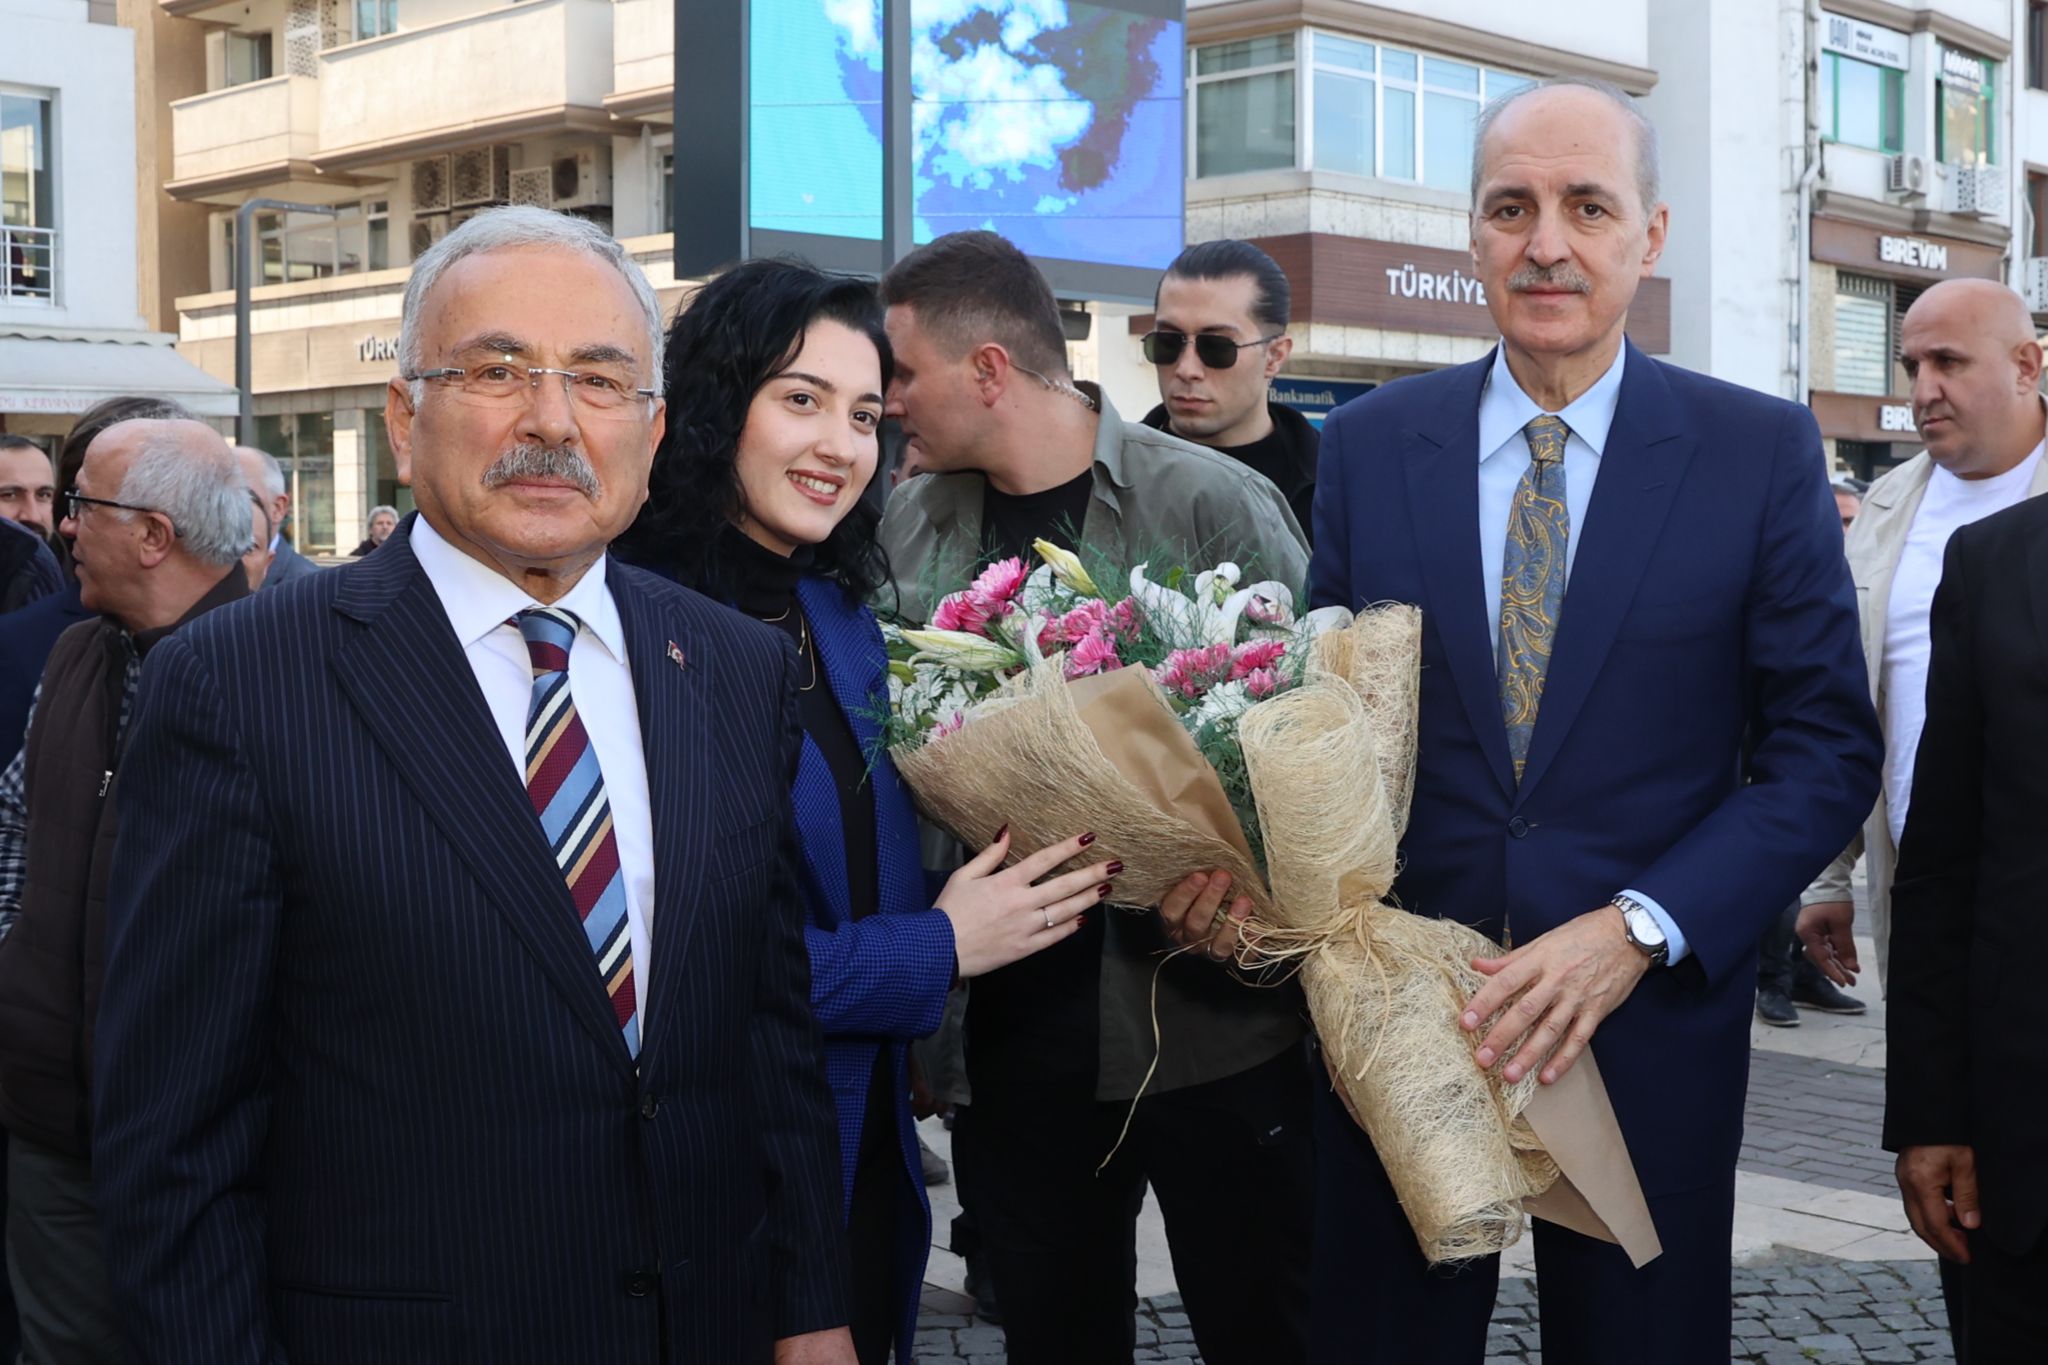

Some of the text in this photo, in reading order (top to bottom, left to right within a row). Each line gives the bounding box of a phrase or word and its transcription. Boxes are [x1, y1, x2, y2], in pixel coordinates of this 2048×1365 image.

[1385, 263, 1488, 306] TÜRKİYE
[355, 335, 400, 361] TÜRK
[1269, 387, 1337, 406] Bankamatik
[1880, 404, 1918, 432] BİRE
